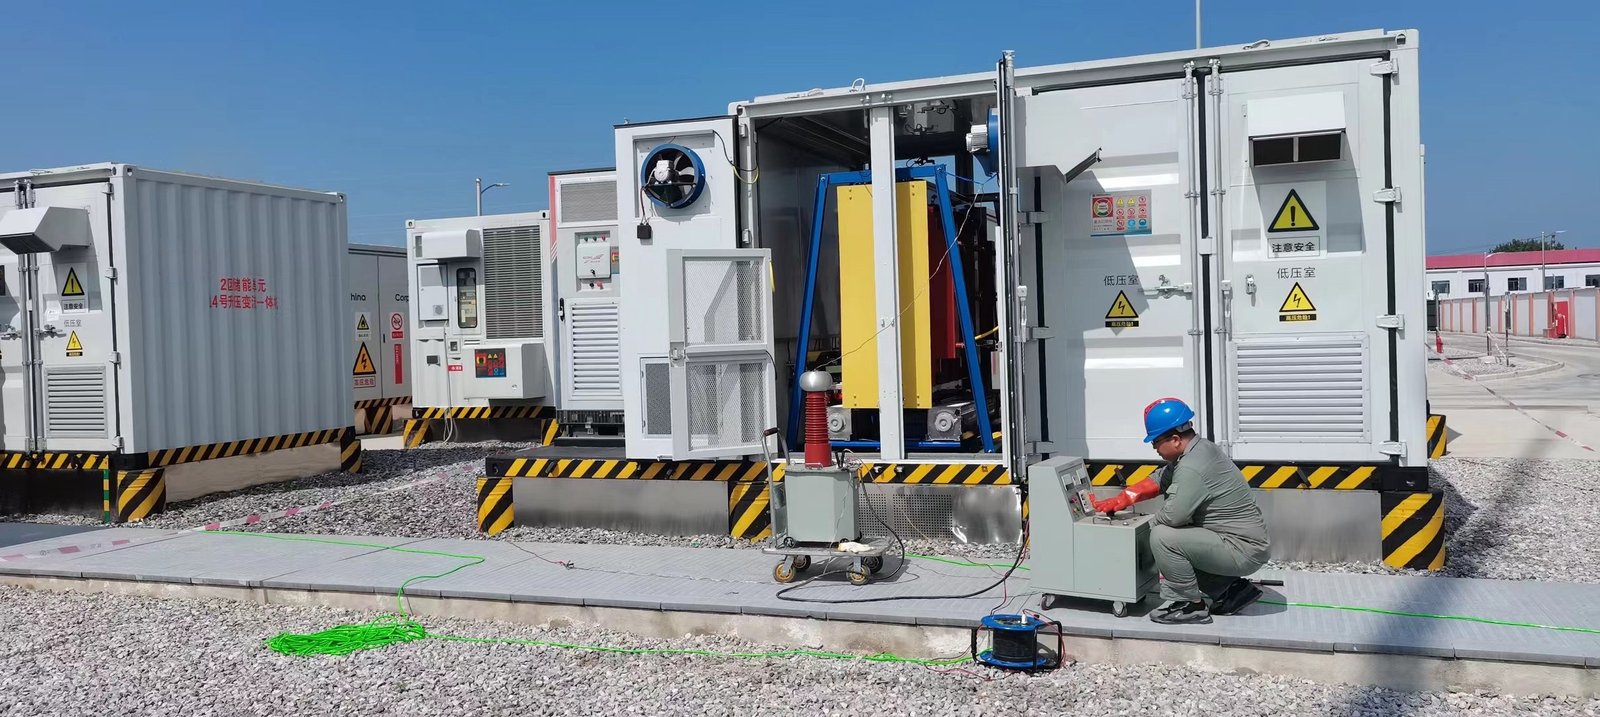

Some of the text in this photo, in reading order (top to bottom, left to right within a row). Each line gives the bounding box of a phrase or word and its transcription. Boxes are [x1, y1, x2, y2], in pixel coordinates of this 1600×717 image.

[1272, 242, 1315, 252] 注意安全
[1277, 267, 1316, 279] 低压室
[1104, 275, 1139, 286] 低压室
